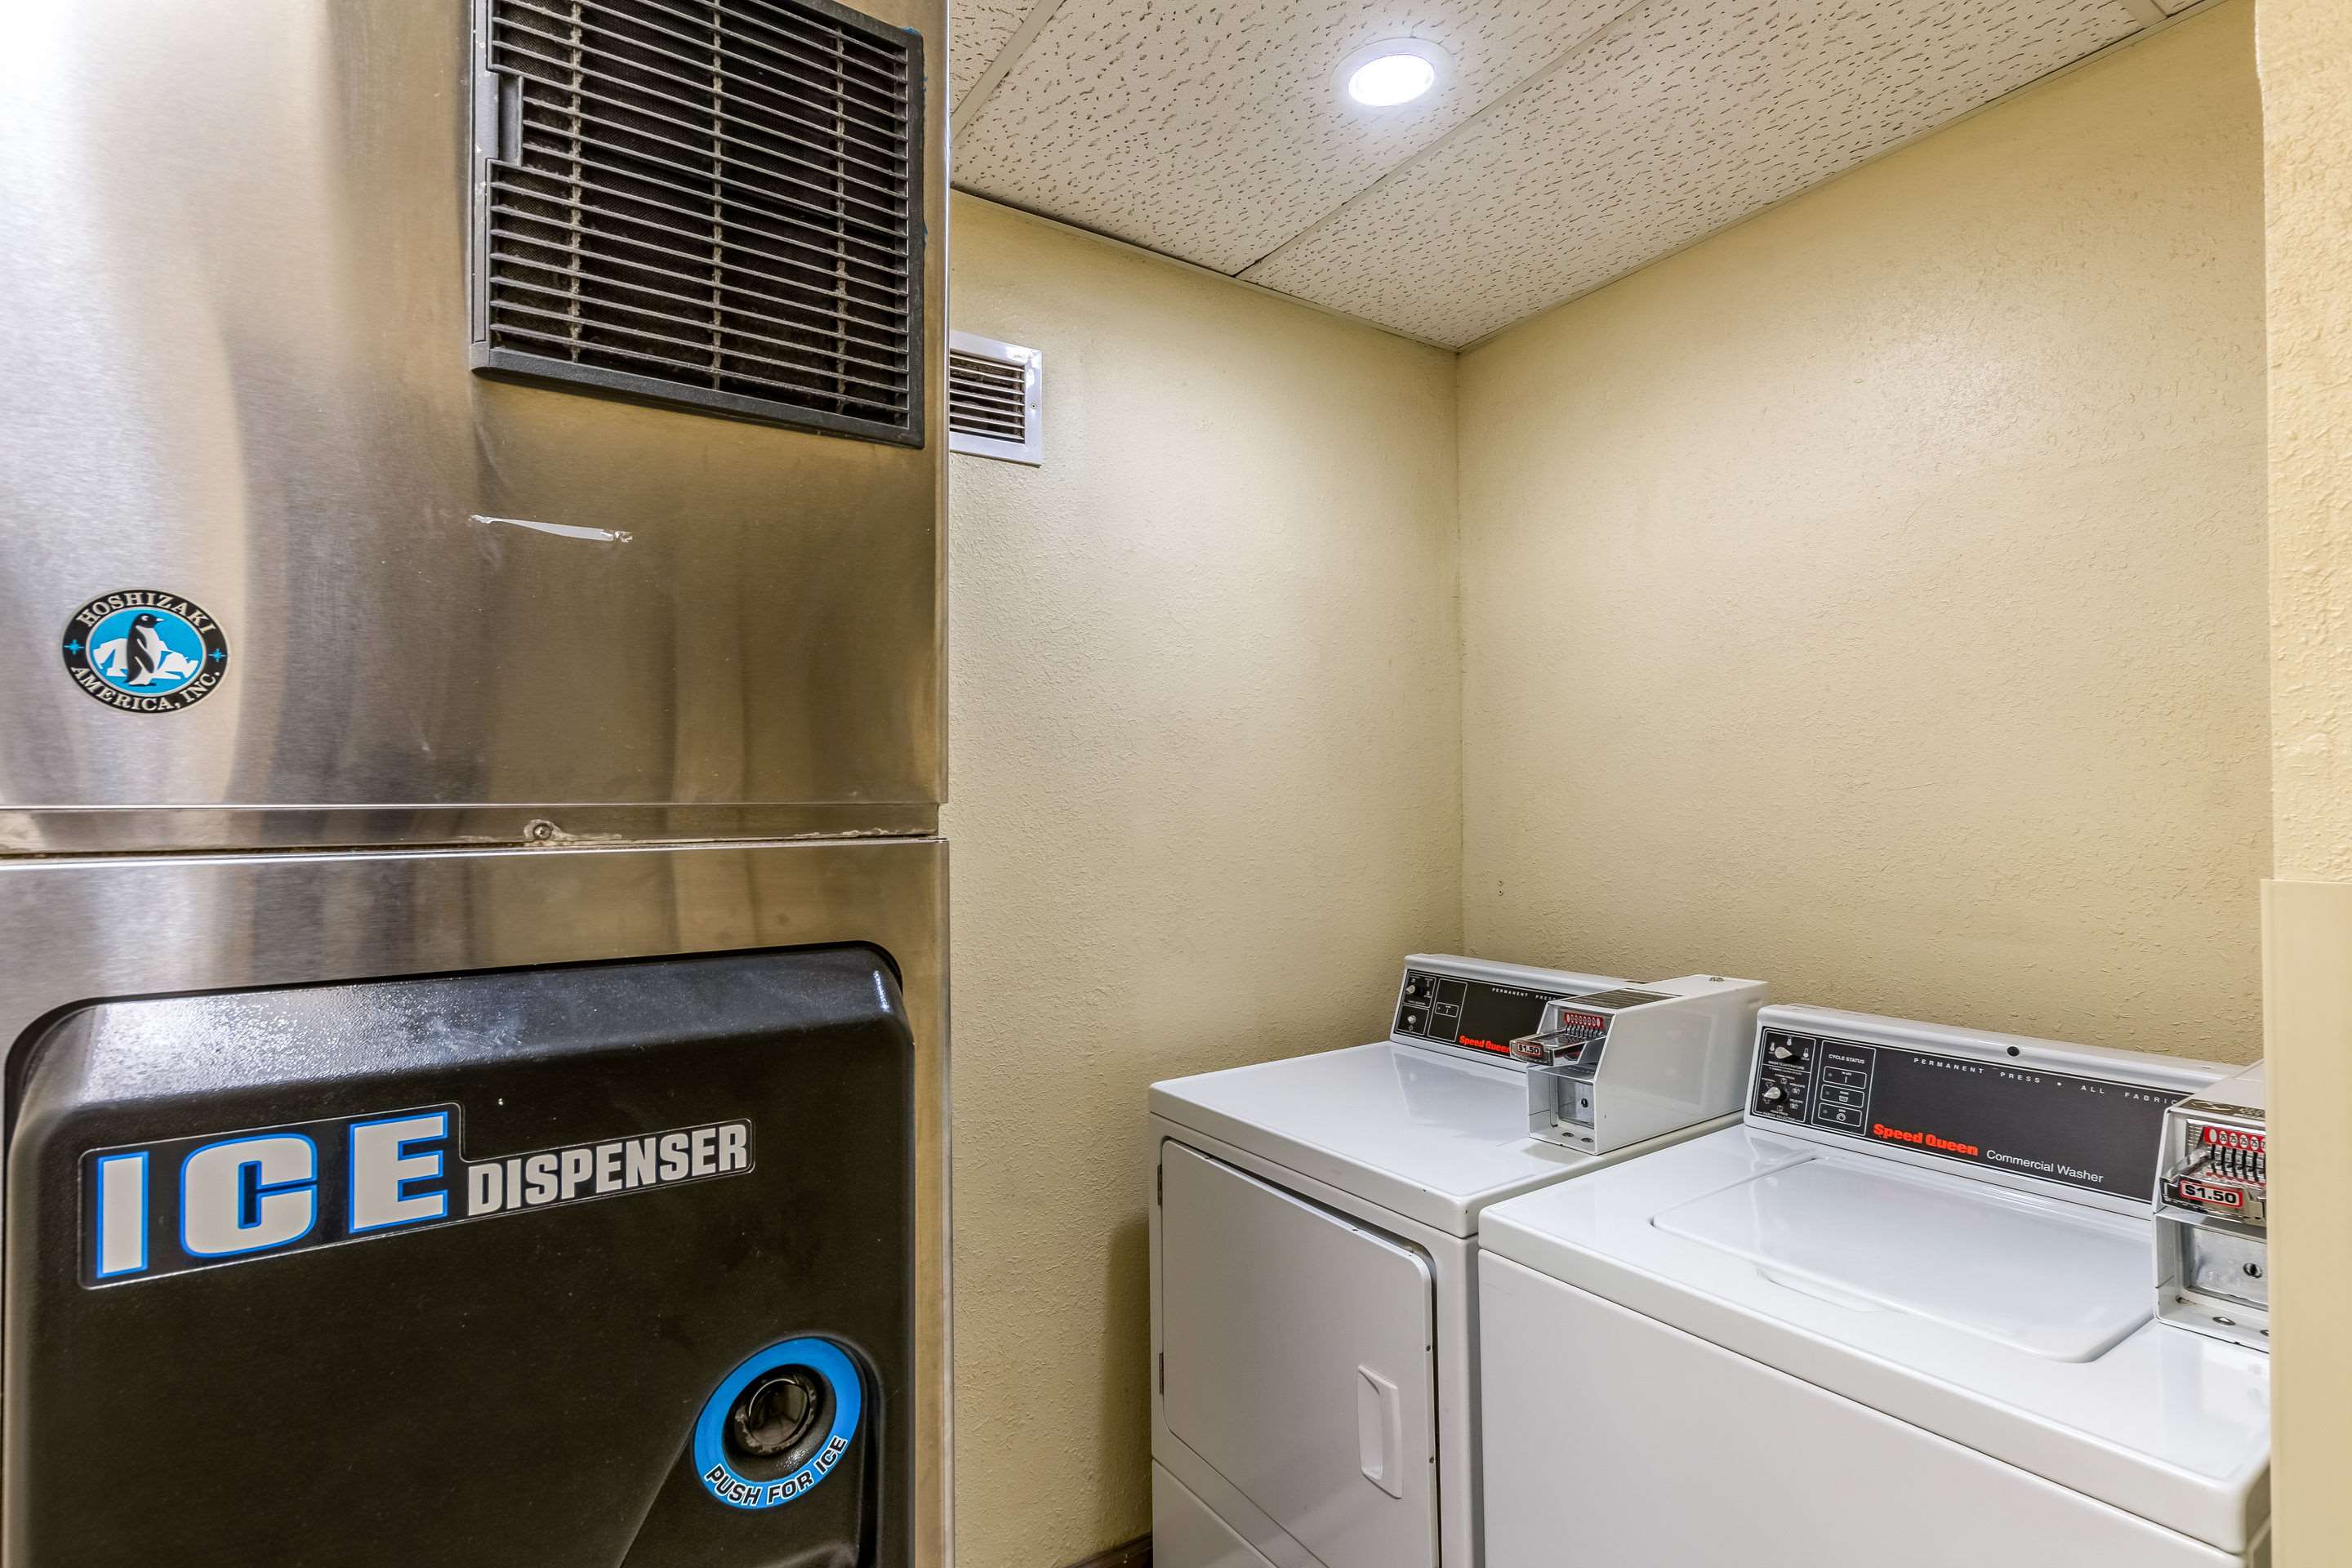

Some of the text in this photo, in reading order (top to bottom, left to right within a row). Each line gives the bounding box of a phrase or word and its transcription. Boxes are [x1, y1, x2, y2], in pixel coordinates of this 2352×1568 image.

[75, 592, 216, 635] HOSHIZAKI
[70, 666, 220, 710] AMERICA, INC.
[1459, 1035, 1485, 1049] Speed
[1518, 1044, 1539, 1054] $1.50
[1913, 1058, 1984, 1074] PERMANENT
[2000, 1071, 2041, 1083] PRESS
[2080, 1085, 2105, 1094] ALL
[1873, 1123, 2105, 1183] Speed Queen Commercial Washer
[96, 1111, 747, 1279] ICE DISPENSER
[2185, 1184, 2237, 1204] $1.50
[704, 1435, 849, 1507] PUSH FOR ICE
